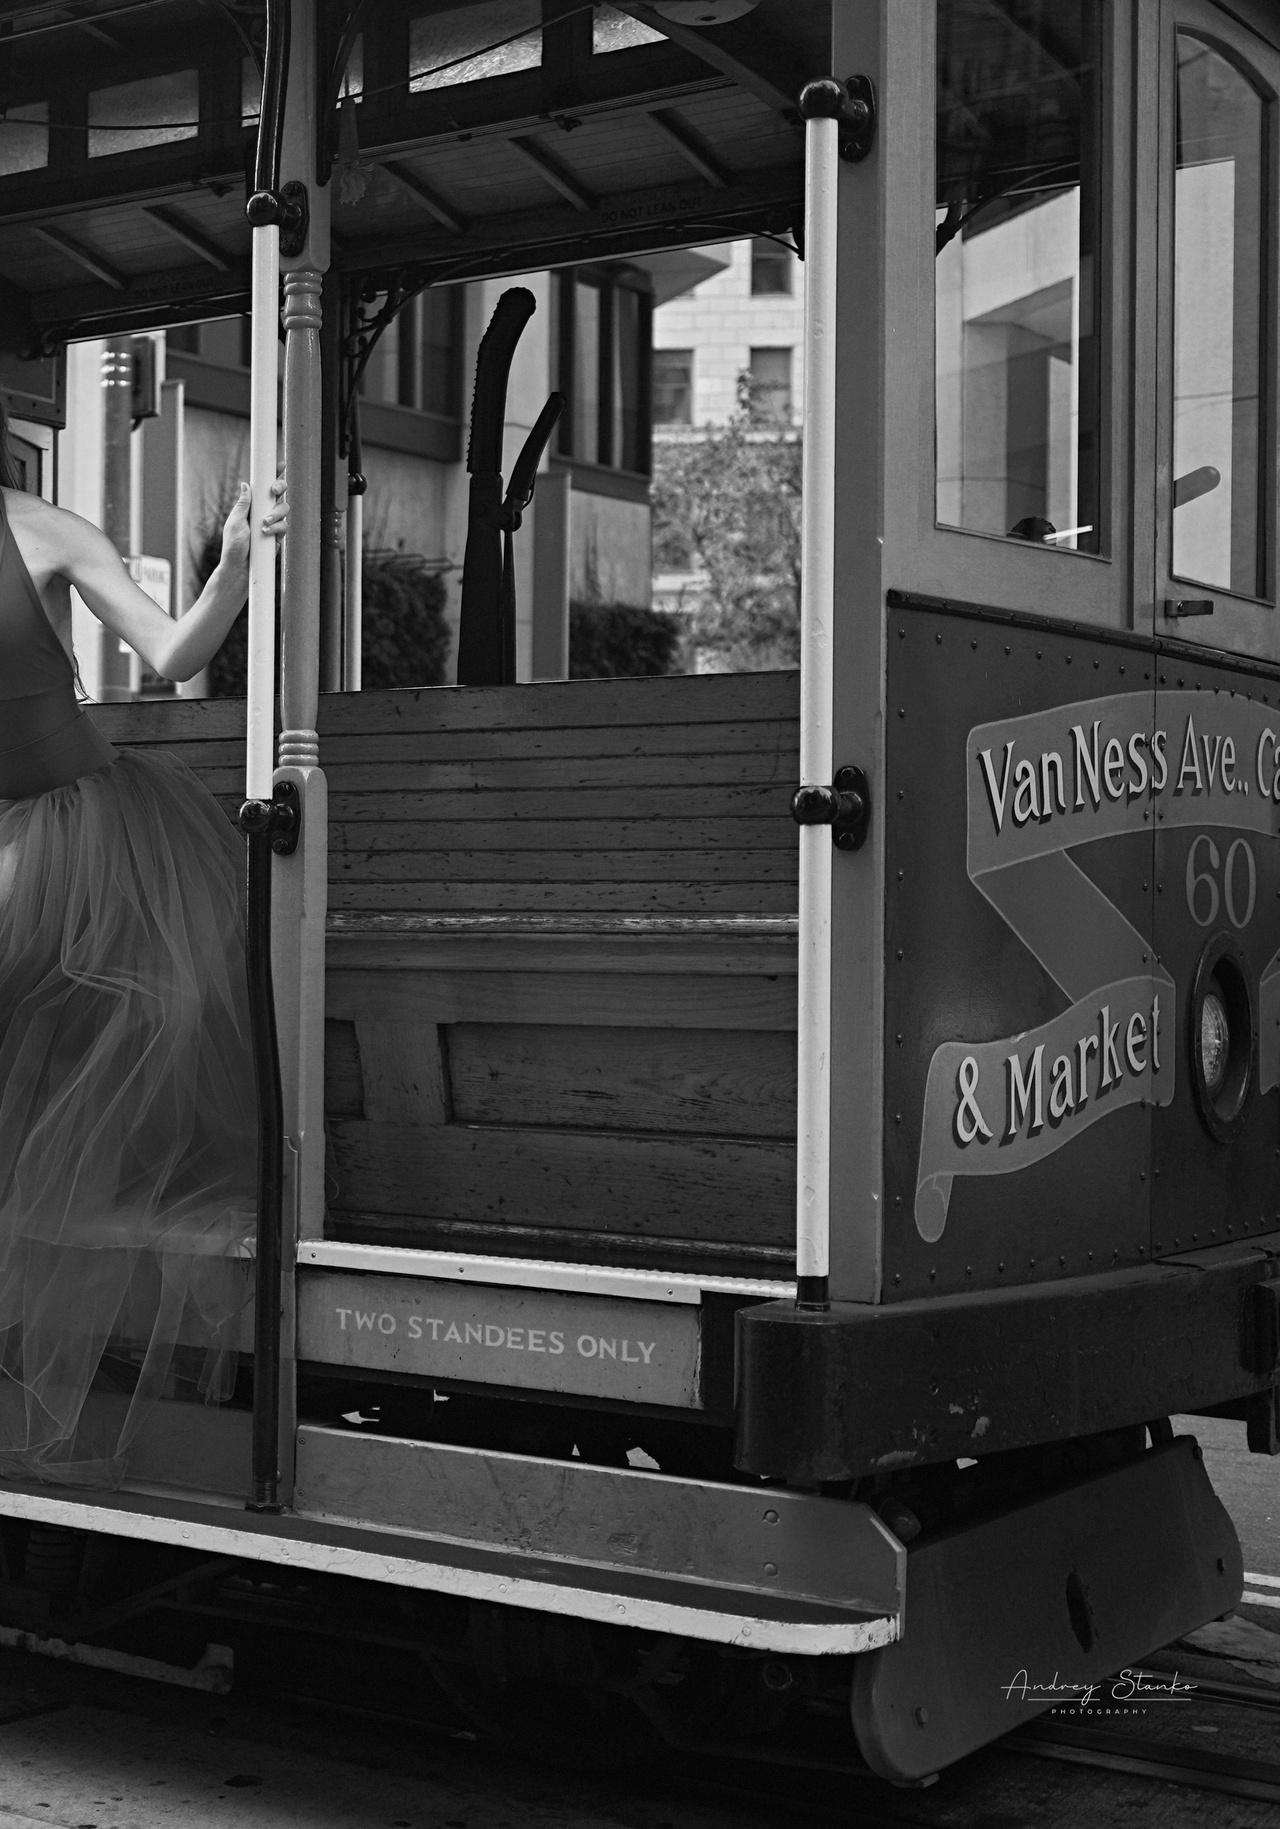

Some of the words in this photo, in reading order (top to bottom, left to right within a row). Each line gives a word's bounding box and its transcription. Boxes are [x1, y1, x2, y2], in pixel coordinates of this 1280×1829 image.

[977, 740, 1066, 835] Van
[1070, 720, 1168, 808] Ness
[1185, 834, 1257, 929] 60
[954, 1056, 994, 1148] &
[1001, 994, 1161, 1146] Market
[335, 1308, 397, 1335] TWO
[408, 1315, 565, 1355] STANDEES
[577, 1334, 657, 1364] ONLY
